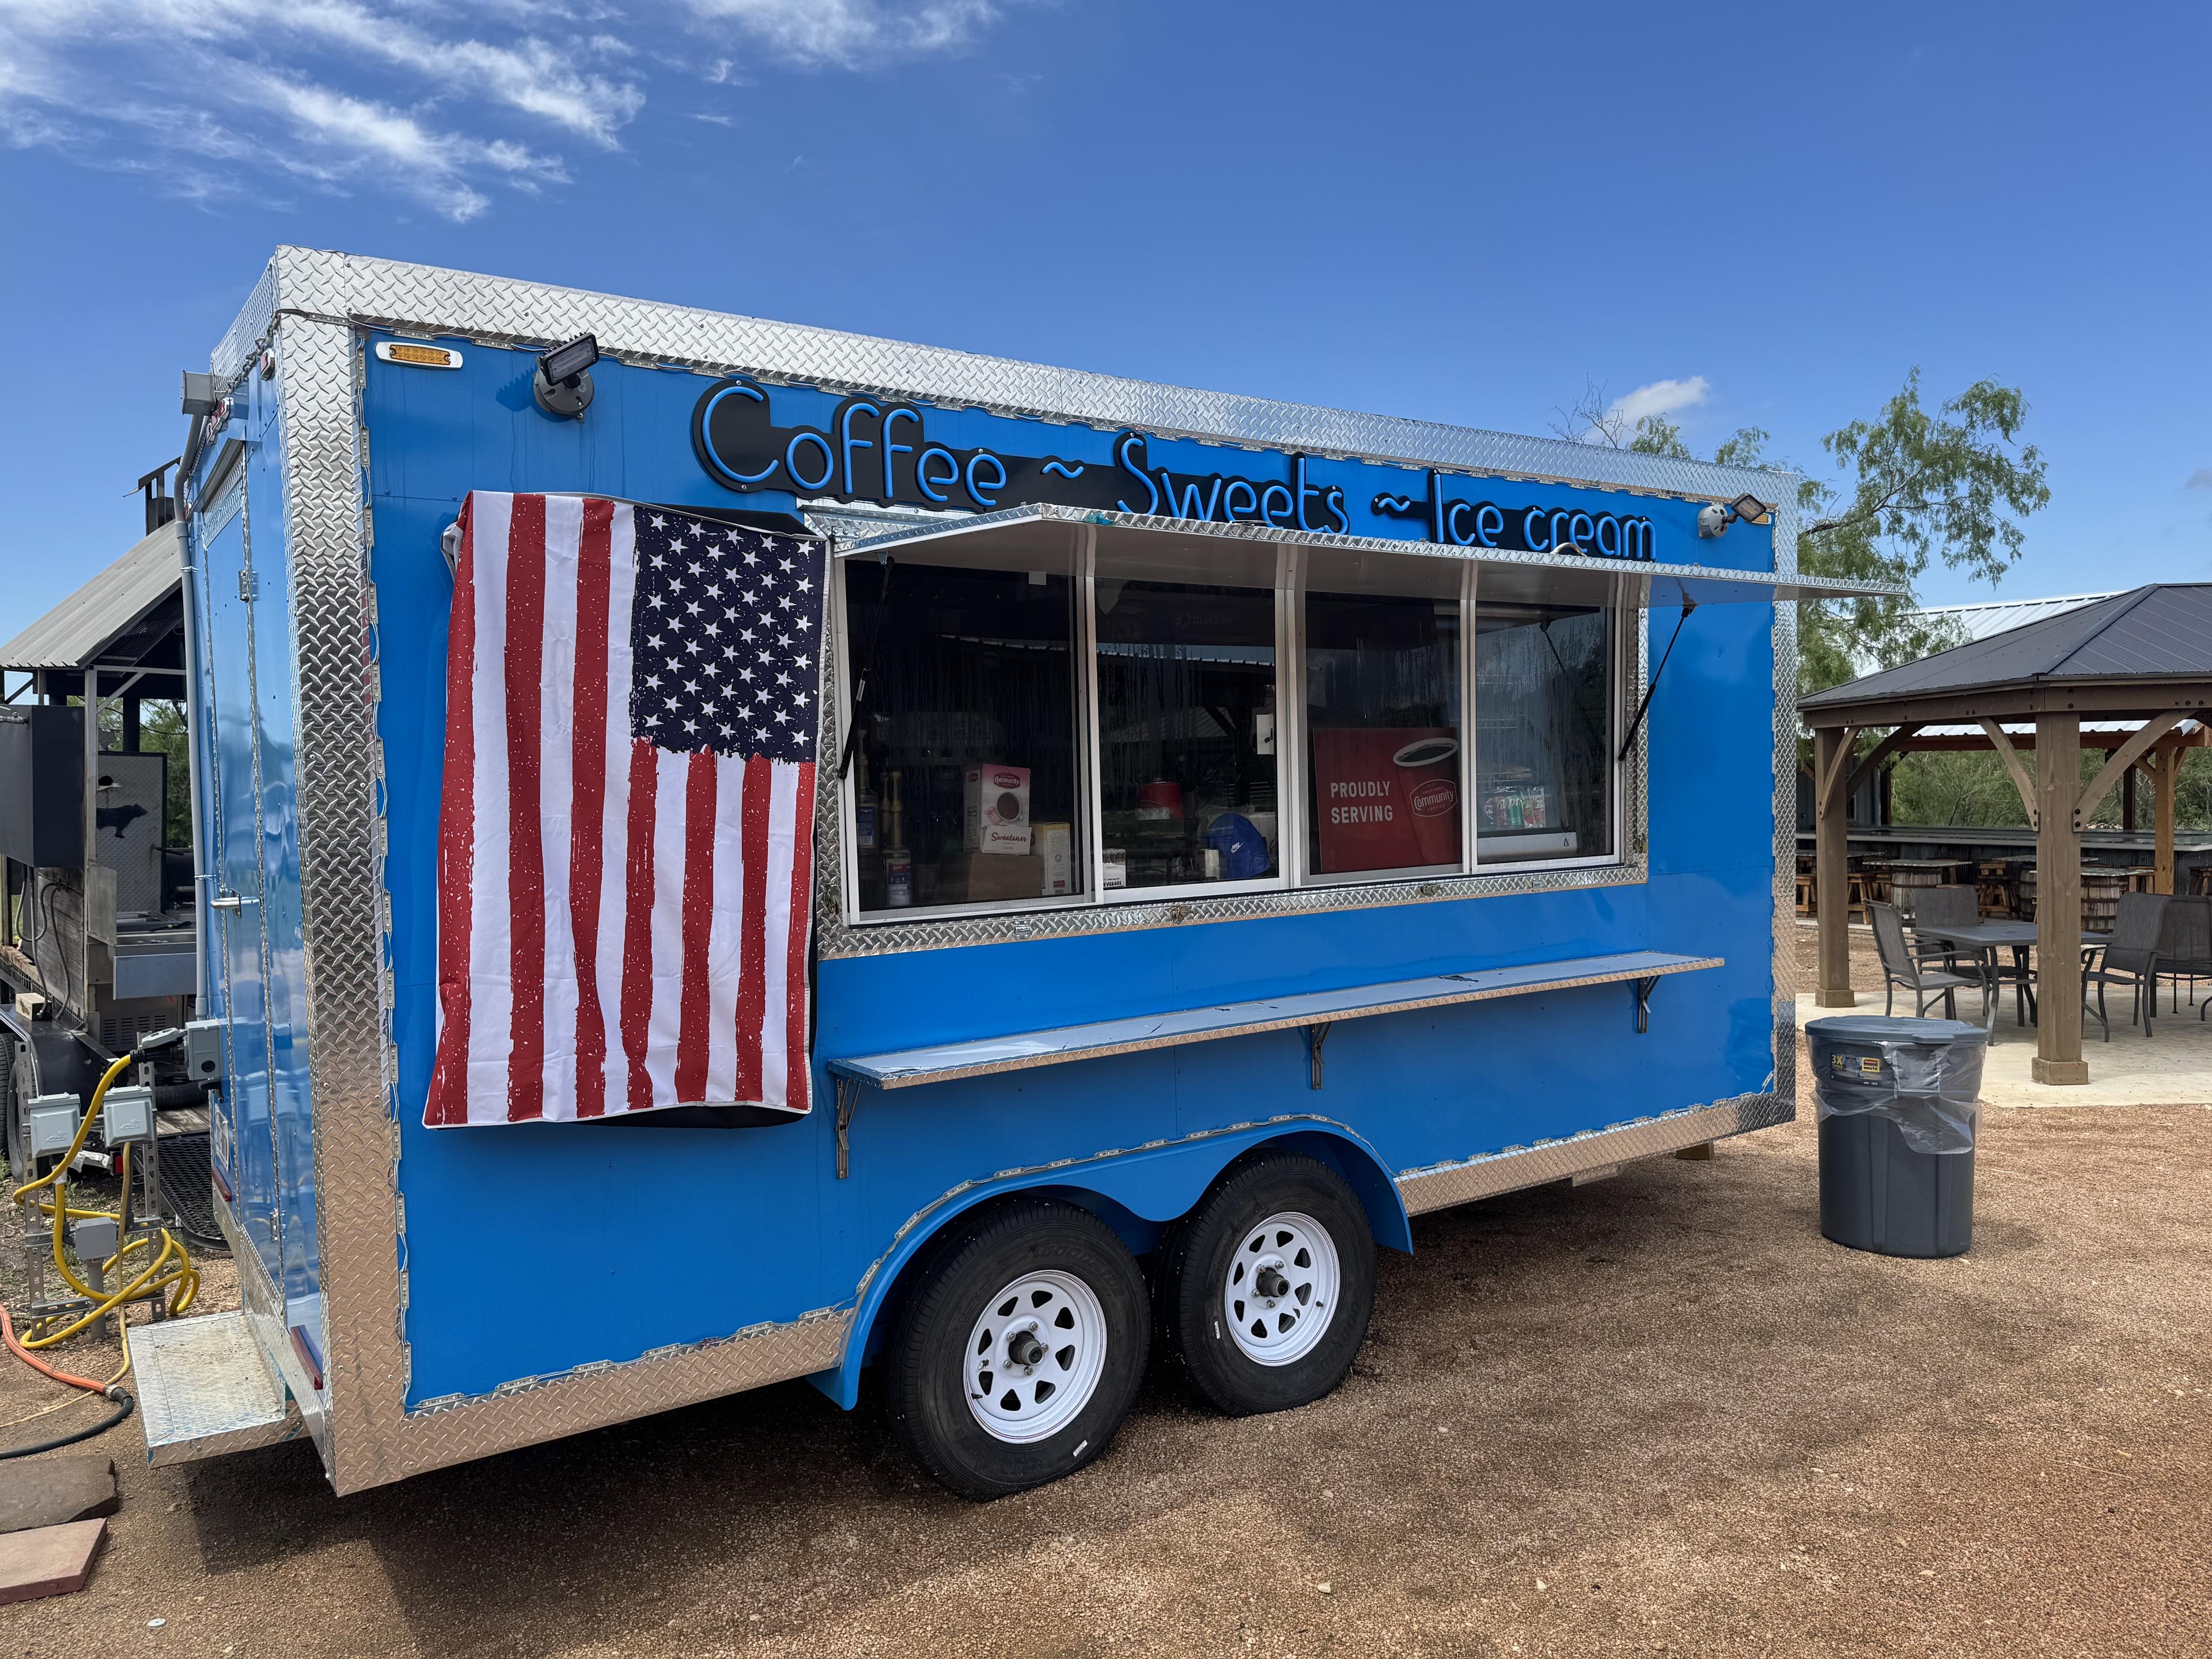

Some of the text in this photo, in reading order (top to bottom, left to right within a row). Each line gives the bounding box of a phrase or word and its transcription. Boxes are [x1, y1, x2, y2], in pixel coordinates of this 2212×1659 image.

[701, 385, 1007, 506] Coffee
[1116, 437, 1350, 536] Sweets
[1433, 473, 1503, 547] Ice
[1523, 506, 1657, 559] cream
[995, 775, 1020, 786] Community
[1330, 781, 1391, 798] PROUDLY
[1414, 788, 1454, 811] Community
[1331, 805, 1393, 824] SERVING
[991, 832, 1027, 842] Sweetener
[1831, 1054, 1843, 1065] 3X
